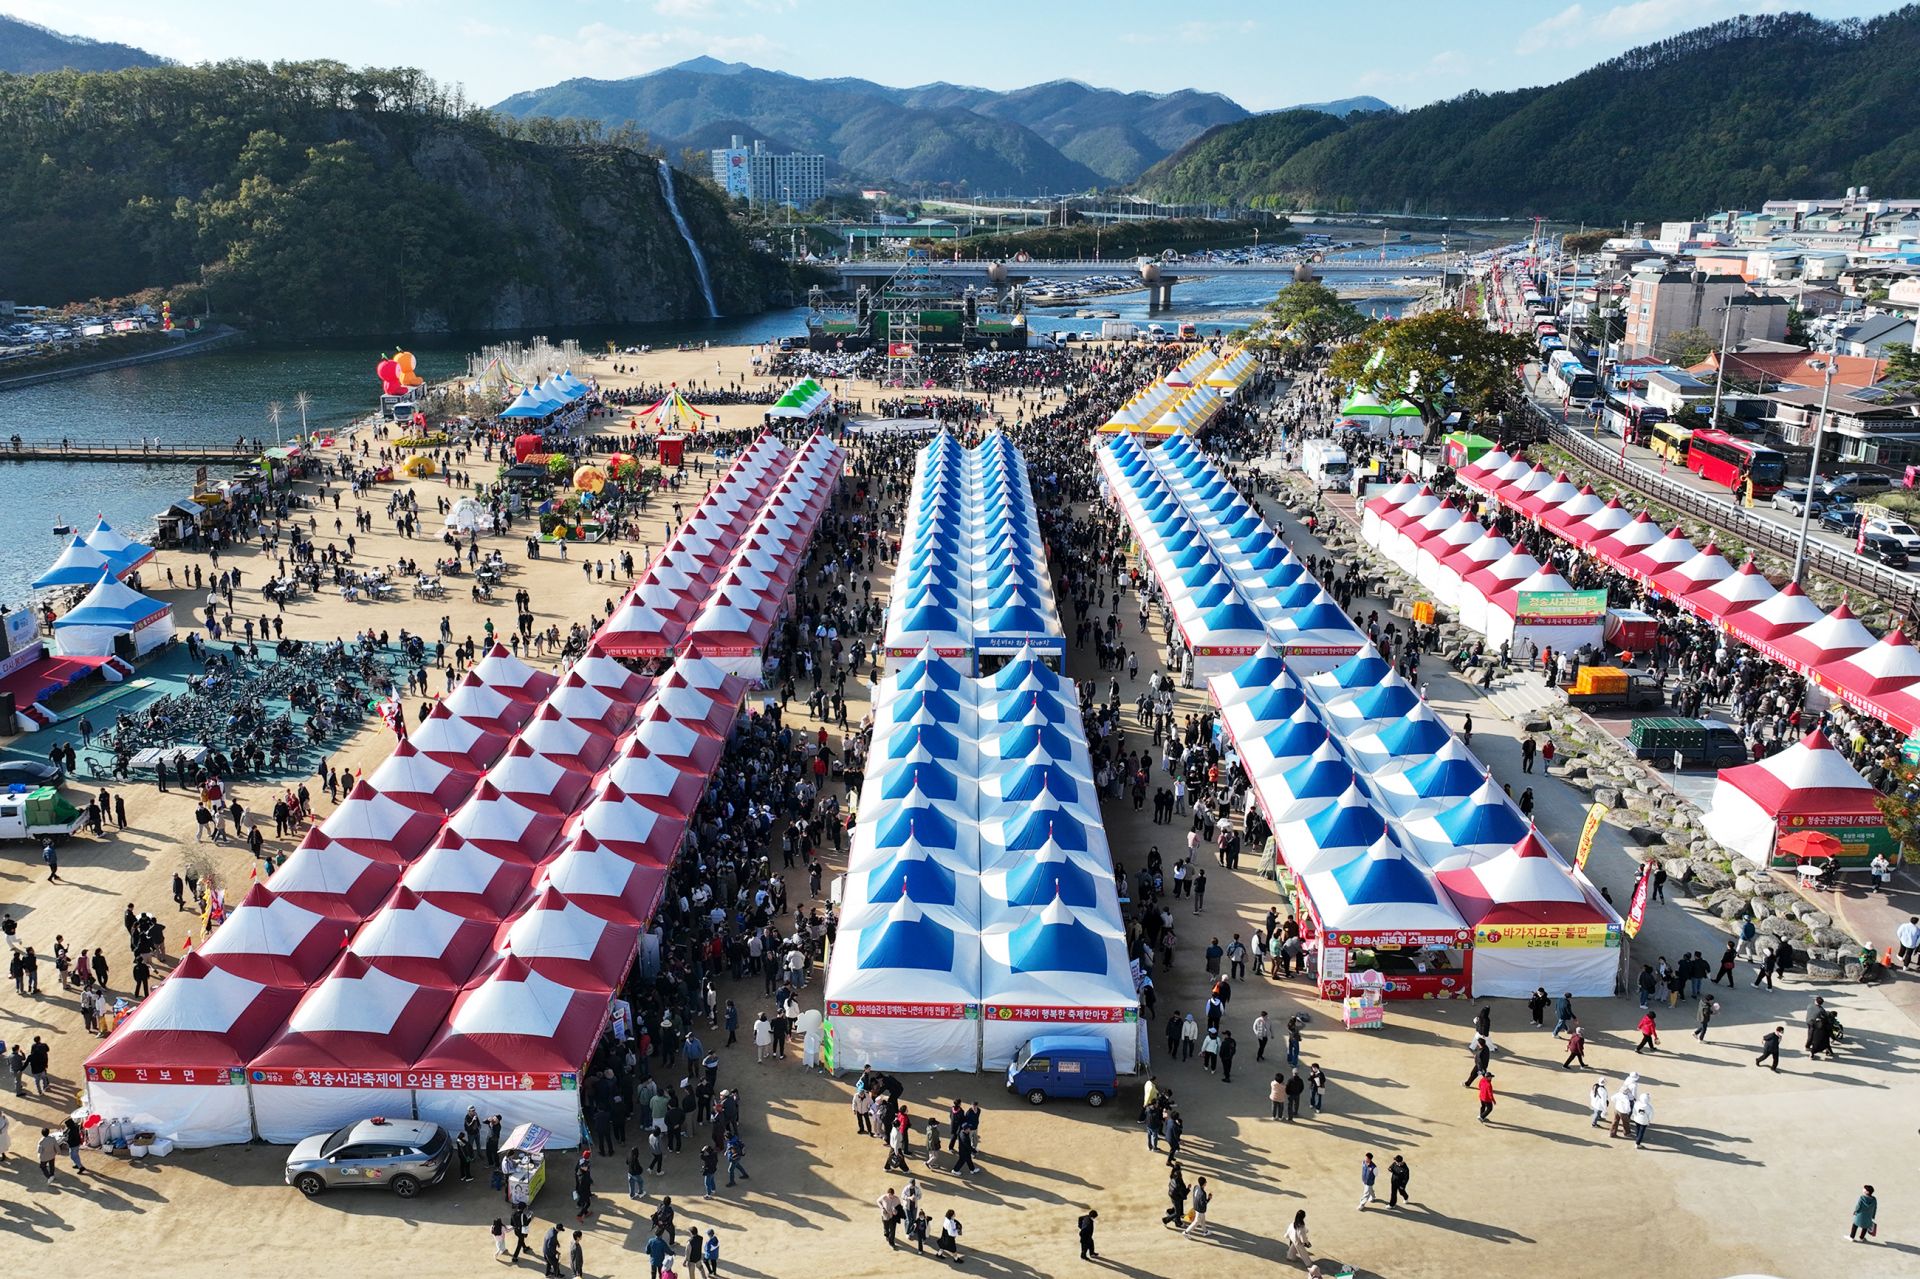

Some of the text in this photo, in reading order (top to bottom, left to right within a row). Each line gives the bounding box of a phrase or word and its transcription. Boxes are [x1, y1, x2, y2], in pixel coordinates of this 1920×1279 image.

[1808, 816, 1827, 825] 청송군
[1353, 935, 1453, 945] 청송사과축제 스탬프투어
[1489, 934, 1498, 942] 51
[1526, 940, 1559, 948] 신고센터
[887, 1005, 907, 1015] 함께하는
[908, 1006, 923, 1016] 나만의
[935, 1006, 950, 1017] 만들기
[1015, 1008, 1040, 1019] 가족이
[1041, 1009, 1066, 1020] 행복한
[1067, 1009, 1109, 1021] 축제한마당
[309, 1071, 518, 1089] 청송사과축제에 오심을 환영합니다
